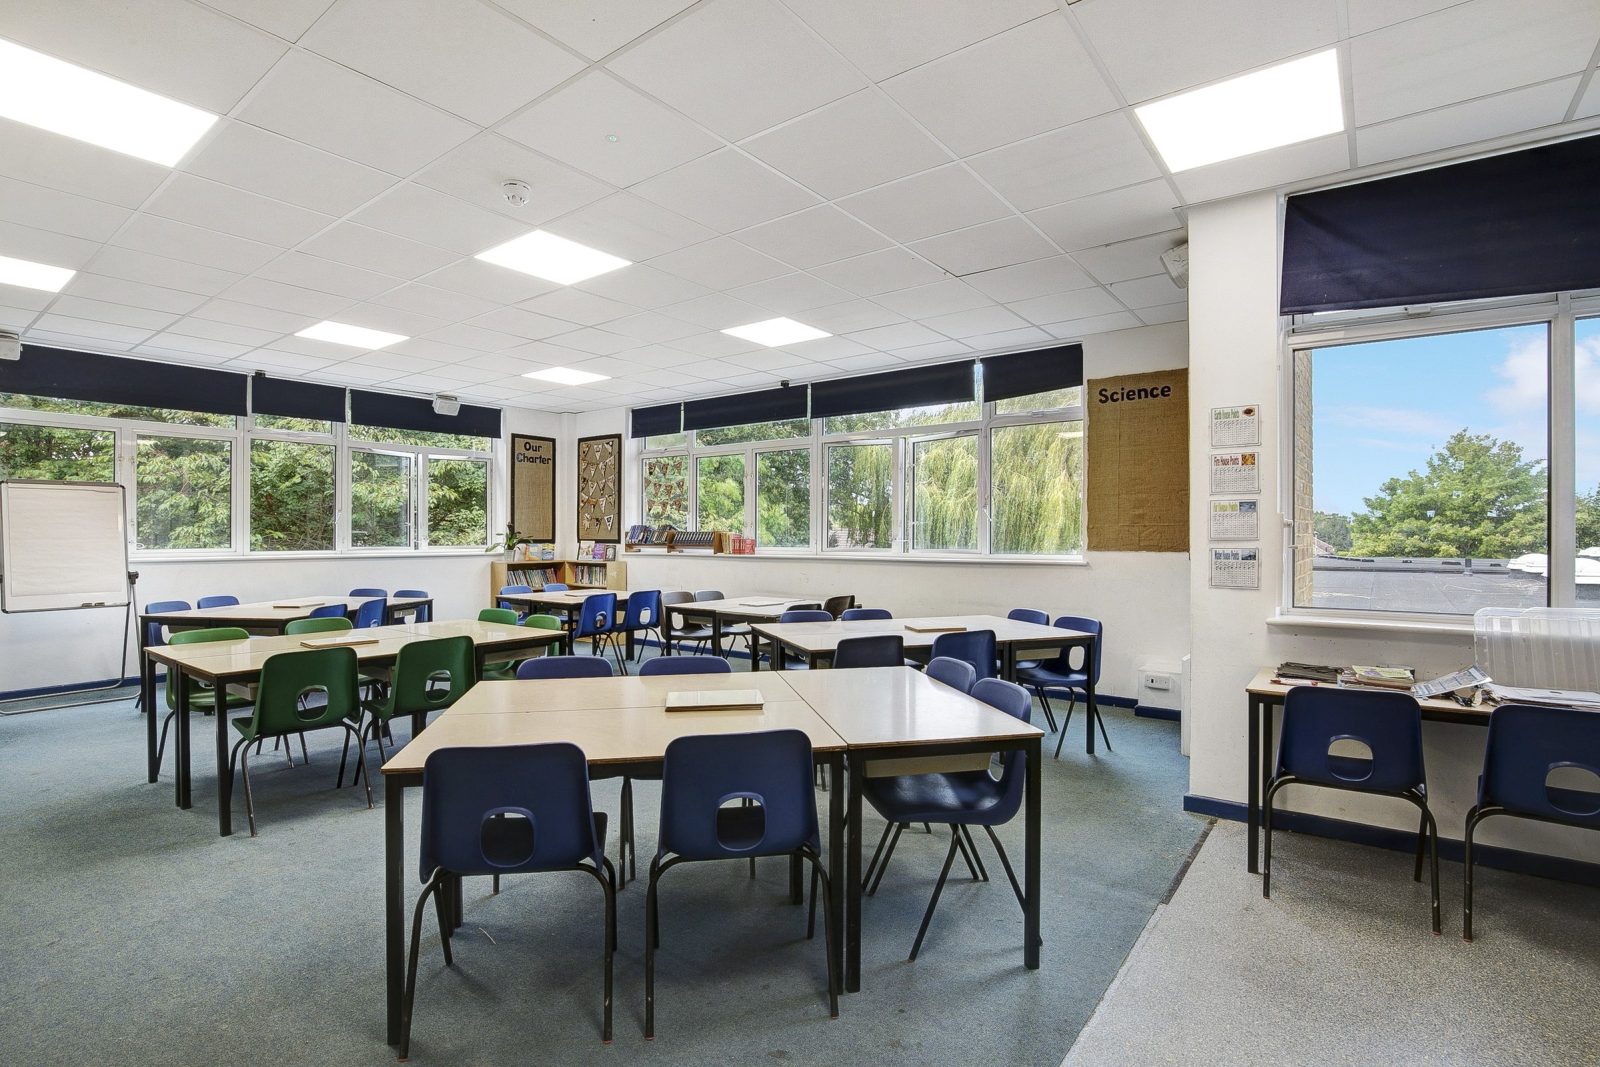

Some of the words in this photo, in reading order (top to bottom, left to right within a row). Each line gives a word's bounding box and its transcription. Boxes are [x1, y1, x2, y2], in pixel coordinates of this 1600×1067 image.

[1098, 385, 1172, 404] Science
[524, 441, 542, 452] Our
[516, 453, 551, 464] Charter
[1220, 456, 1229, 466] House
[1230, 455, 1239, 465] Points
[1222, 550, 1230, 560] House
[1231, 550, 1239, 560] Points
